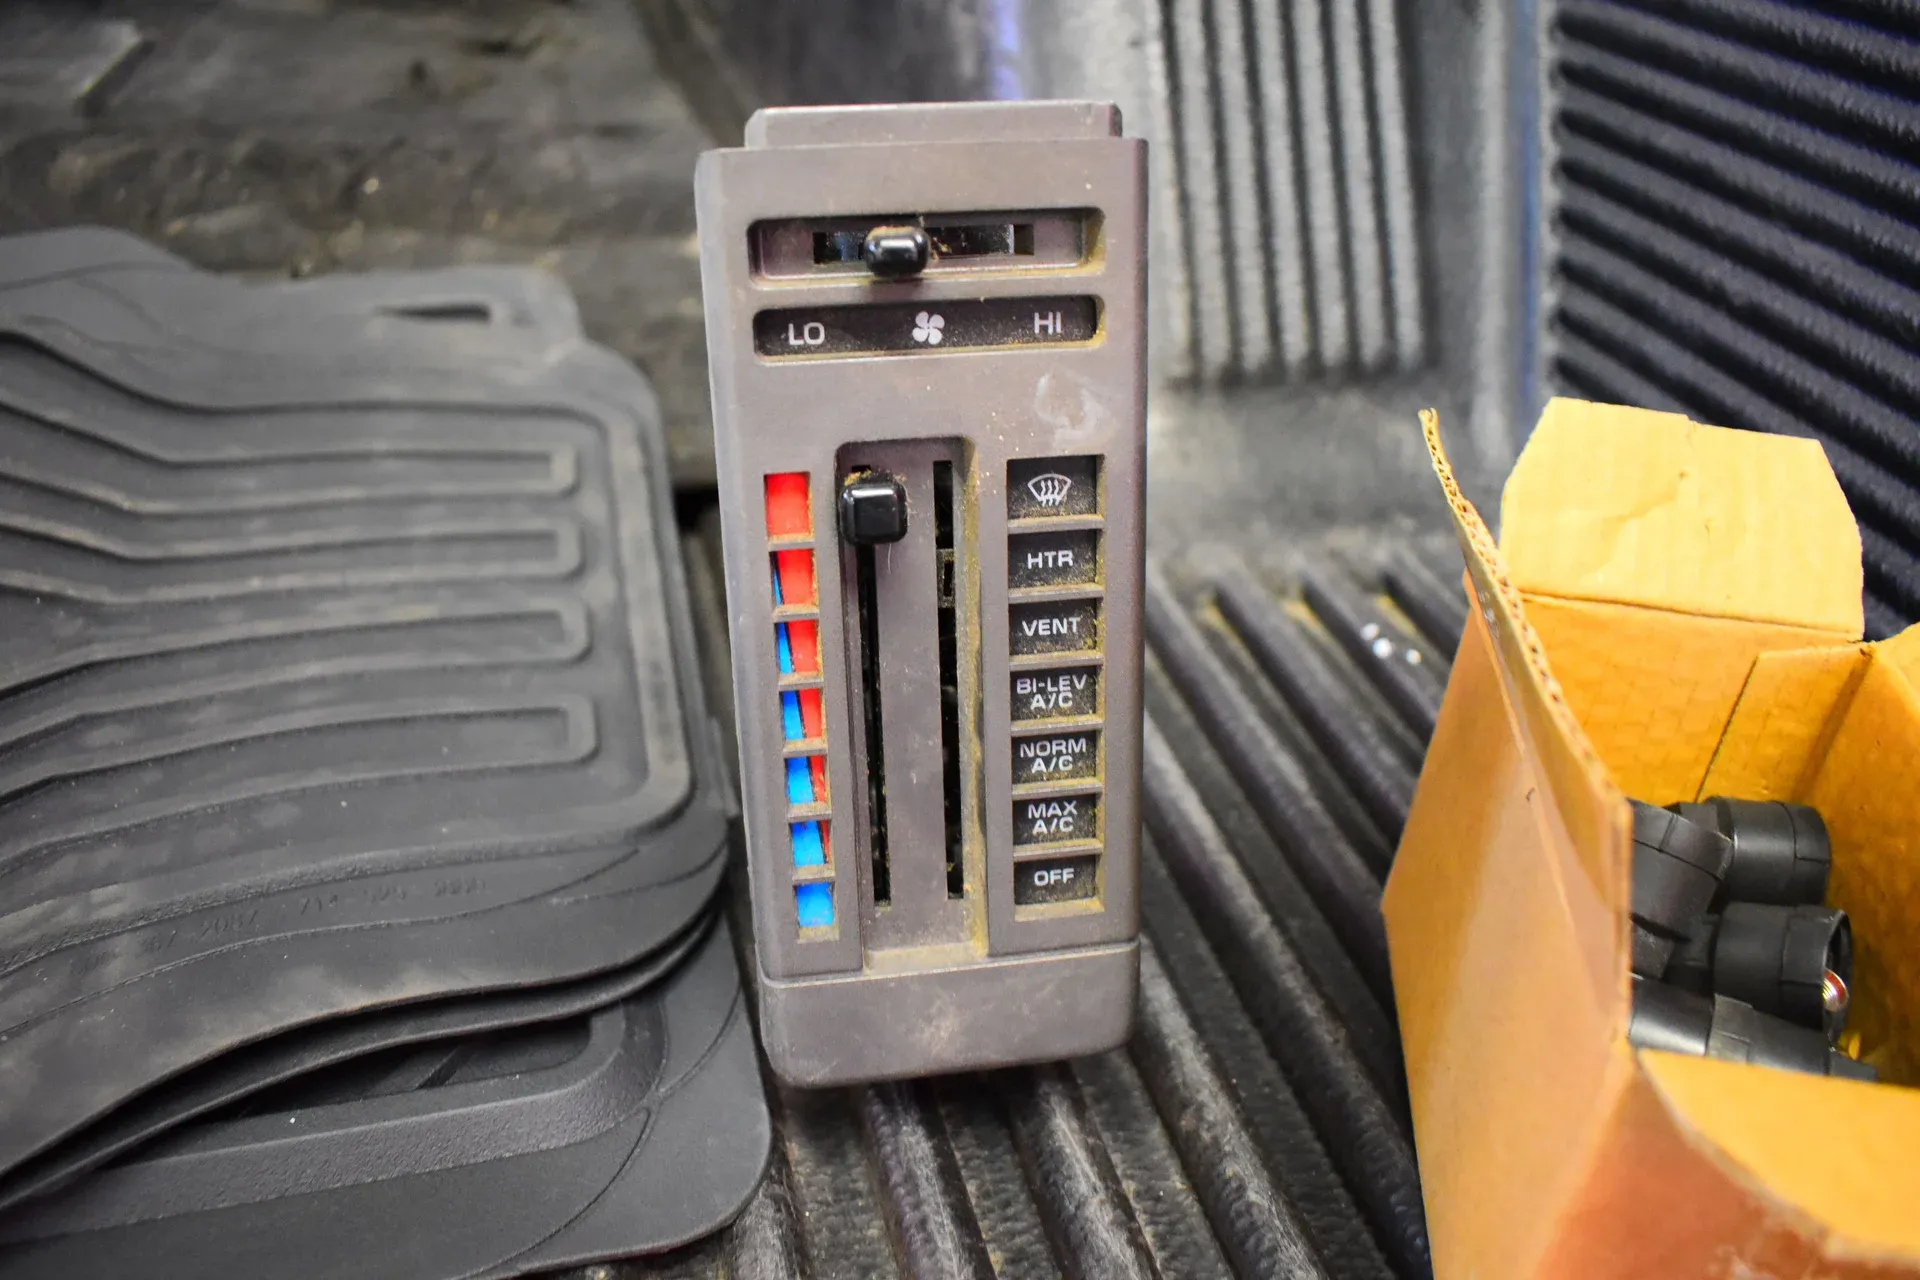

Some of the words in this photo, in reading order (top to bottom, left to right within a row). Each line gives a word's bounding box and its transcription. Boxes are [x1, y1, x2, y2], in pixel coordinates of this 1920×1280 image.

[788, 322, 825, 345] LO
[1033, 311, 1062, 334] HI
[1027, 550, 1074, 569] HTR
[1022, 617, 1080, 636] VENT
[1016, 674, 1087, 694] BI-LEV
[1029, 693, 1073, 710] A/C
[1020, 738, 1086, 758] NORM
[1031, 756, 1073, 773] A/C
[1027, 801, 1077, 819] MAX
[1032, 816, 1073, 834] A/C
[1033, 868, 1074, 886] OFF
